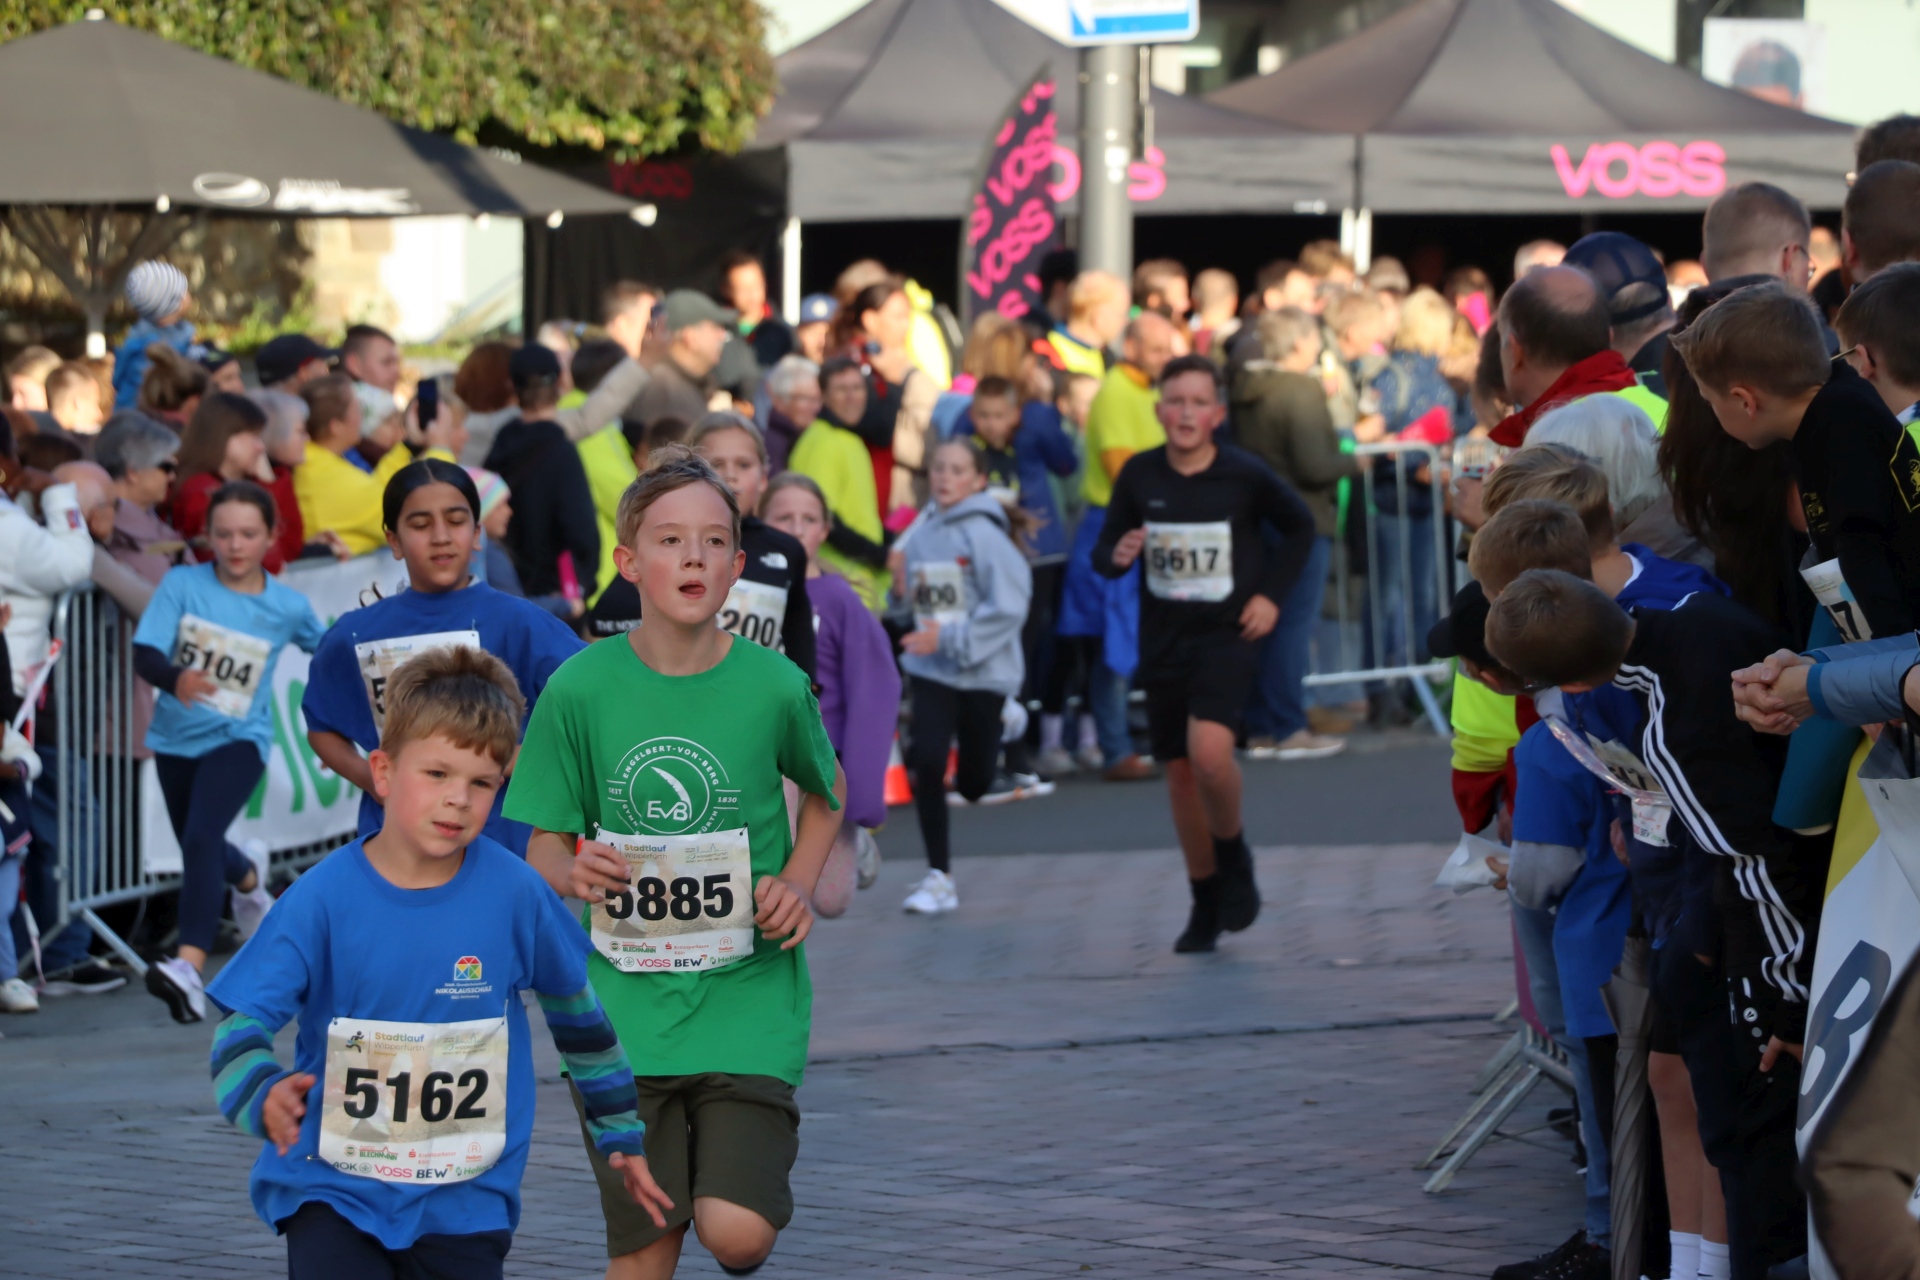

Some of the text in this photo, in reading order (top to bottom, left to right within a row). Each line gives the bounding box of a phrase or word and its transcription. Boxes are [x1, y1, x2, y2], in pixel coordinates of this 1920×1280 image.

[1550, 140, 1727, 198] VOSS
[966, 198, 1055, 299] VOSS
[1152, 547, 1219, 572] 5617
[721, 608, 777, 649] 200
[181, 642, 253, 687] 5104
[622, 745, 719, 786] ENGELBERT-VON-BERG
[624, 843, 667, 852] Stadtlauf
[625, 852, 668, 860] Wipperfürth
[605, 873, 734, 921] 5885
[608, 957, 622, 966] OK
[637, 958, 671, 967] VOSS
[674, 957, 703, 967] BEW
[435, 985, 492, 994] NIKOLAUSSCHULE
[375, 1031, 425, 1042] Stadtlauf
[374, 1042, 425, 1051] Wipperfürth
[344, 1067, 489, 1122] 5162
[334, 1161, 358, 1171] AOK
[374, 1164, 413, 1178] VOSS
[464, 1165, 489, 1175] Helio
[416, 1168, 449, 1179] BEW
